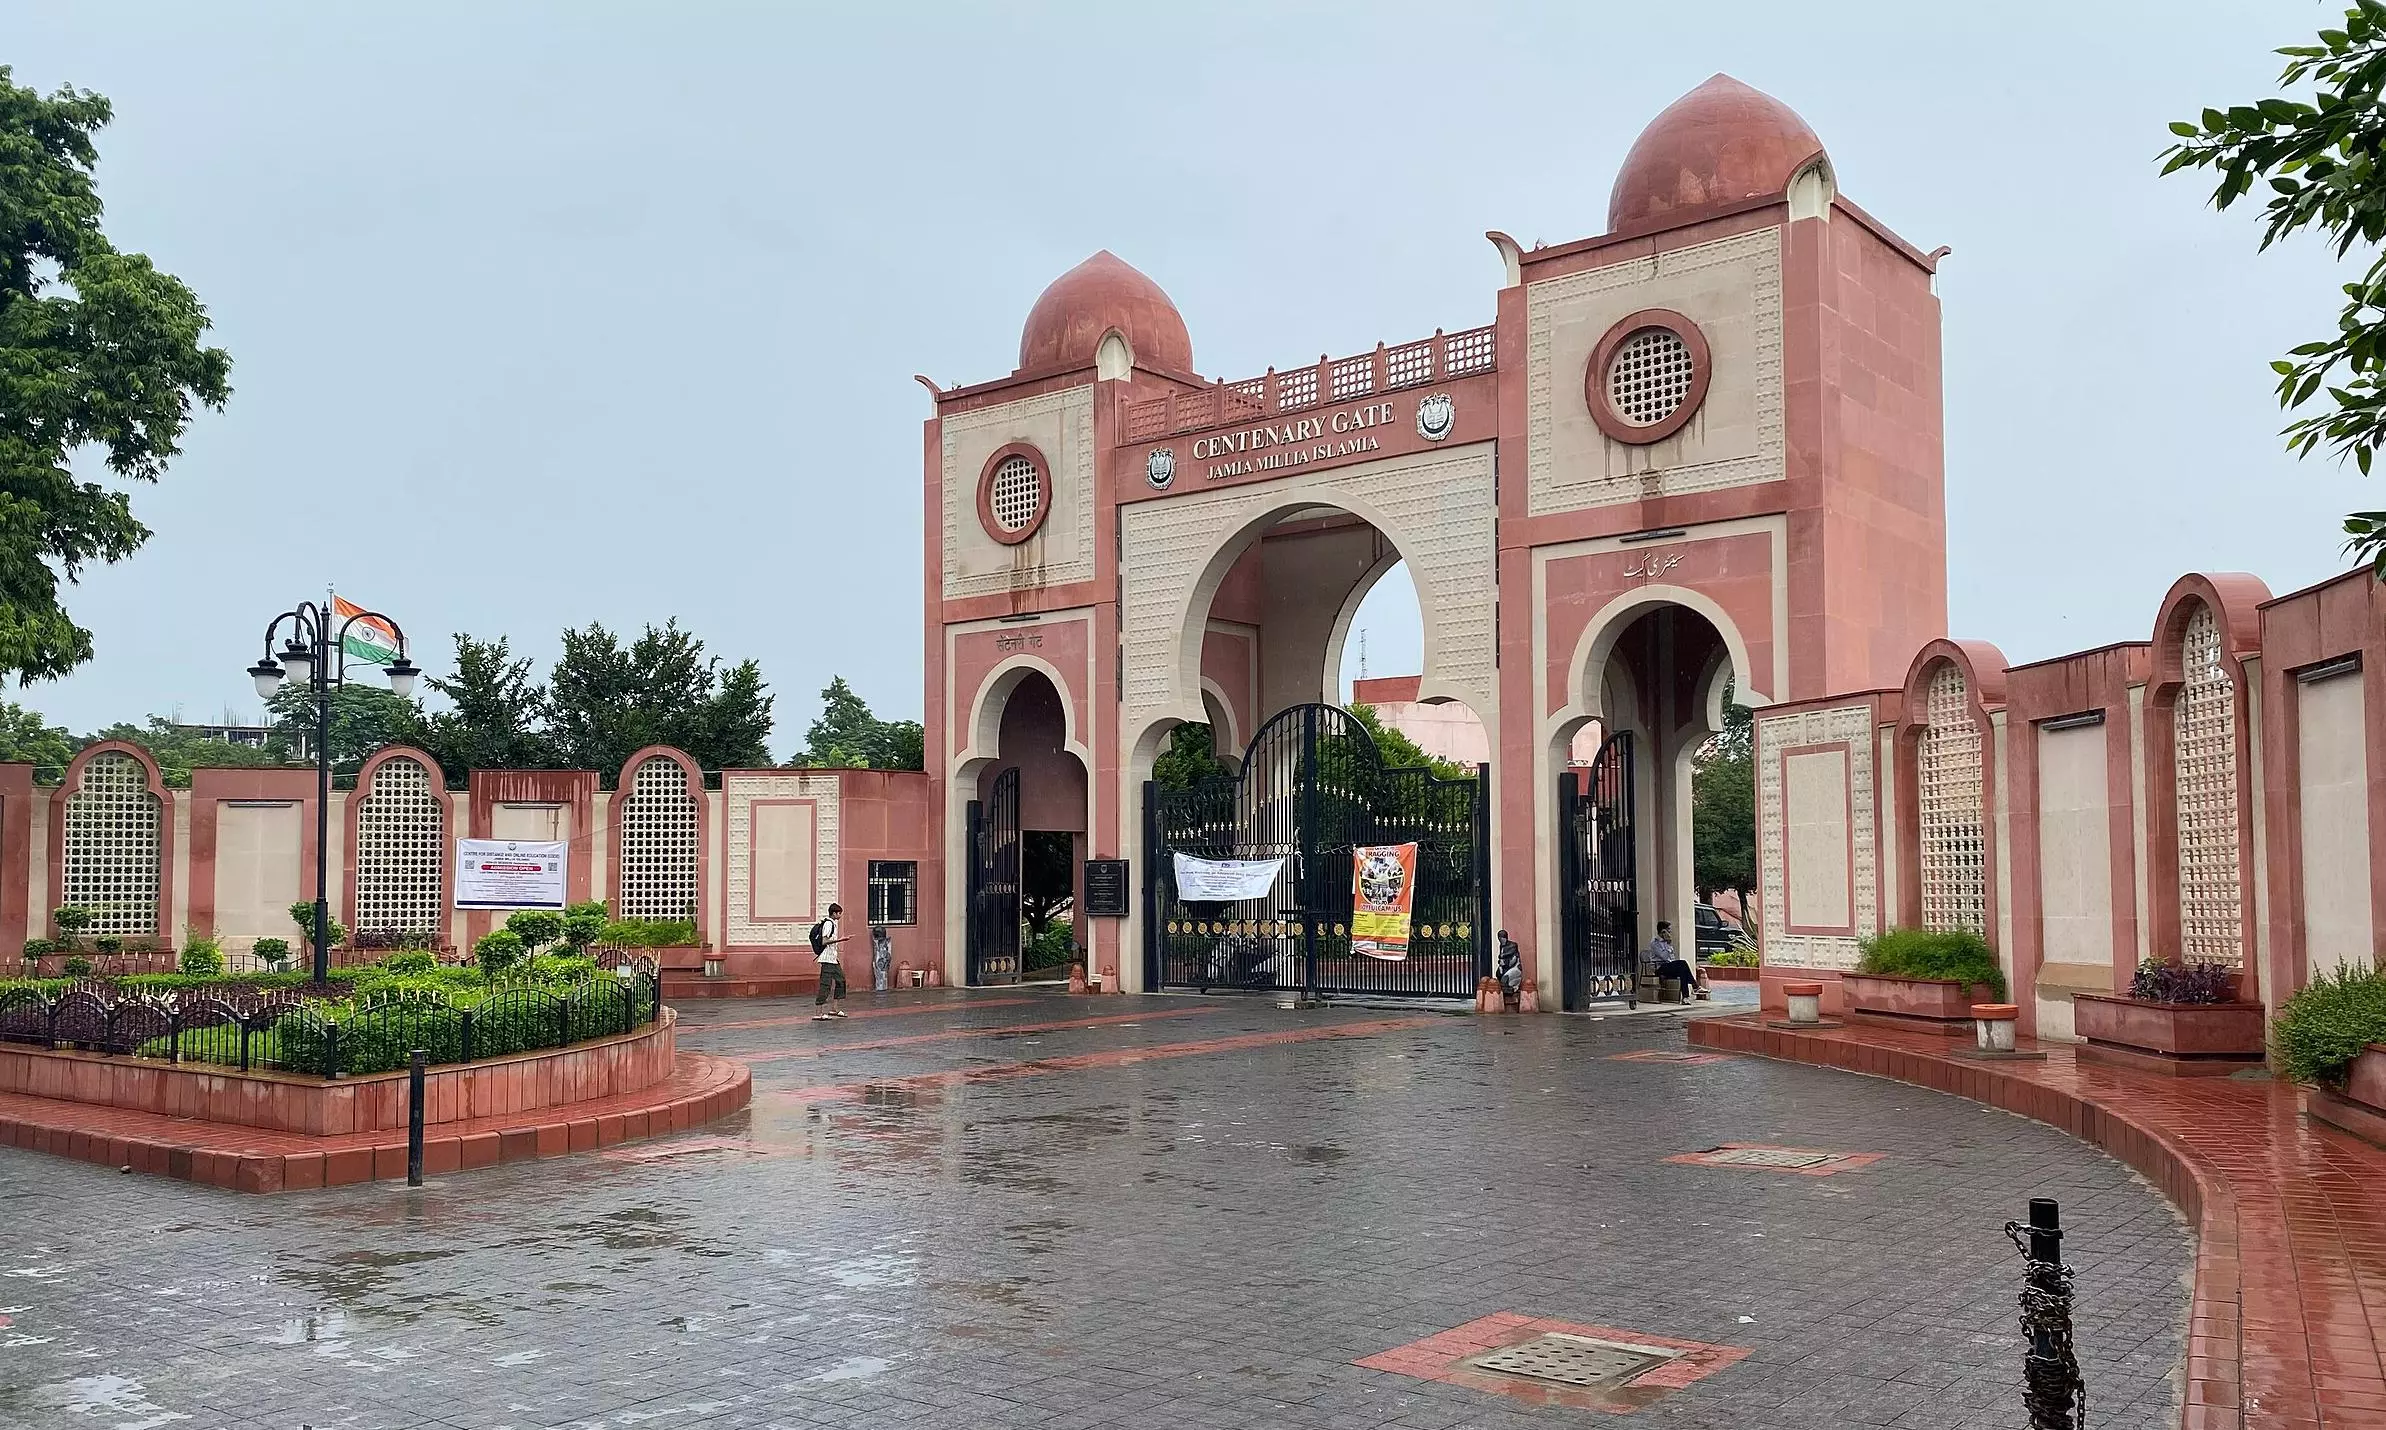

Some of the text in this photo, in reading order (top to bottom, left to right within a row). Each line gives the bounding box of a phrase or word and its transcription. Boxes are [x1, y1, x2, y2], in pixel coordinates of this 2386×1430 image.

[1193, 415, 1327, 460] CENTENARY
[1332, 402, 1396, 433] GATE
[1207, 436, 1380, 480] JAMIA MILLIA ISLAMIA
